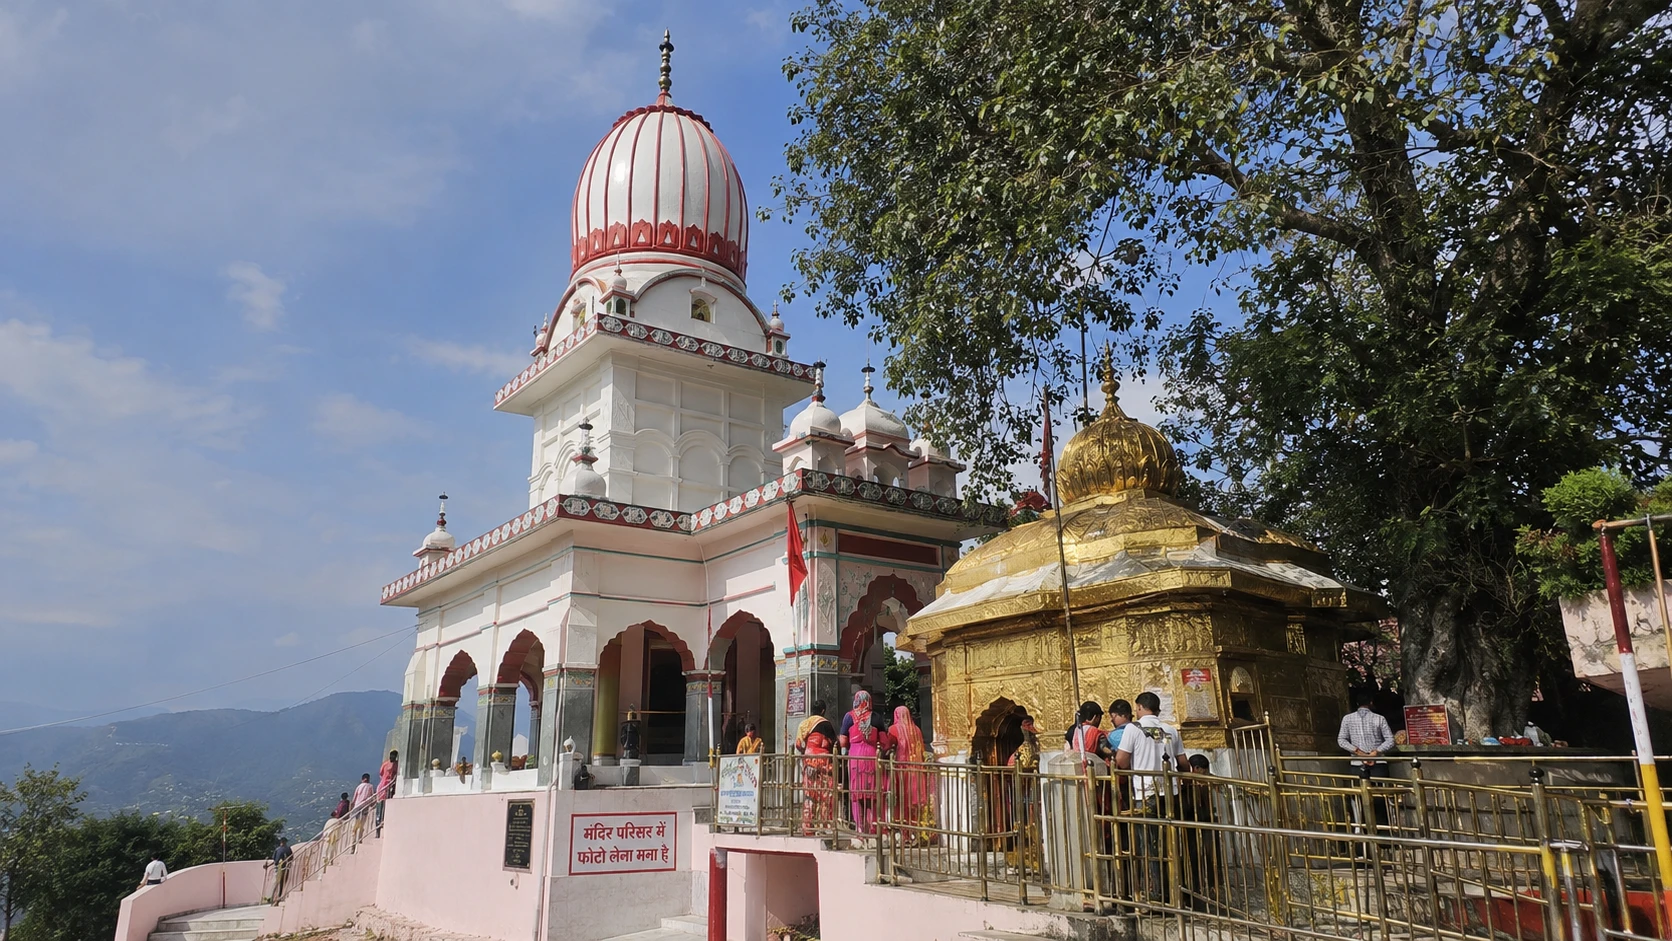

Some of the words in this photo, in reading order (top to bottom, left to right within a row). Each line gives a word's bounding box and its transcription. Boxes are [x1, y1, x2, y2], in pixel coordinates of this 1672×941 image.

[583, 822, 613, 840] मंदिर
[617, 821, 653, 839] परिसर
[656, 821, 666, 837] में
[577, 846, 606, 864] फोटो
[609, 846, 633, 862] लेना
[636, 848, 658, 861] मना
[661, 843, 669, 863] है
